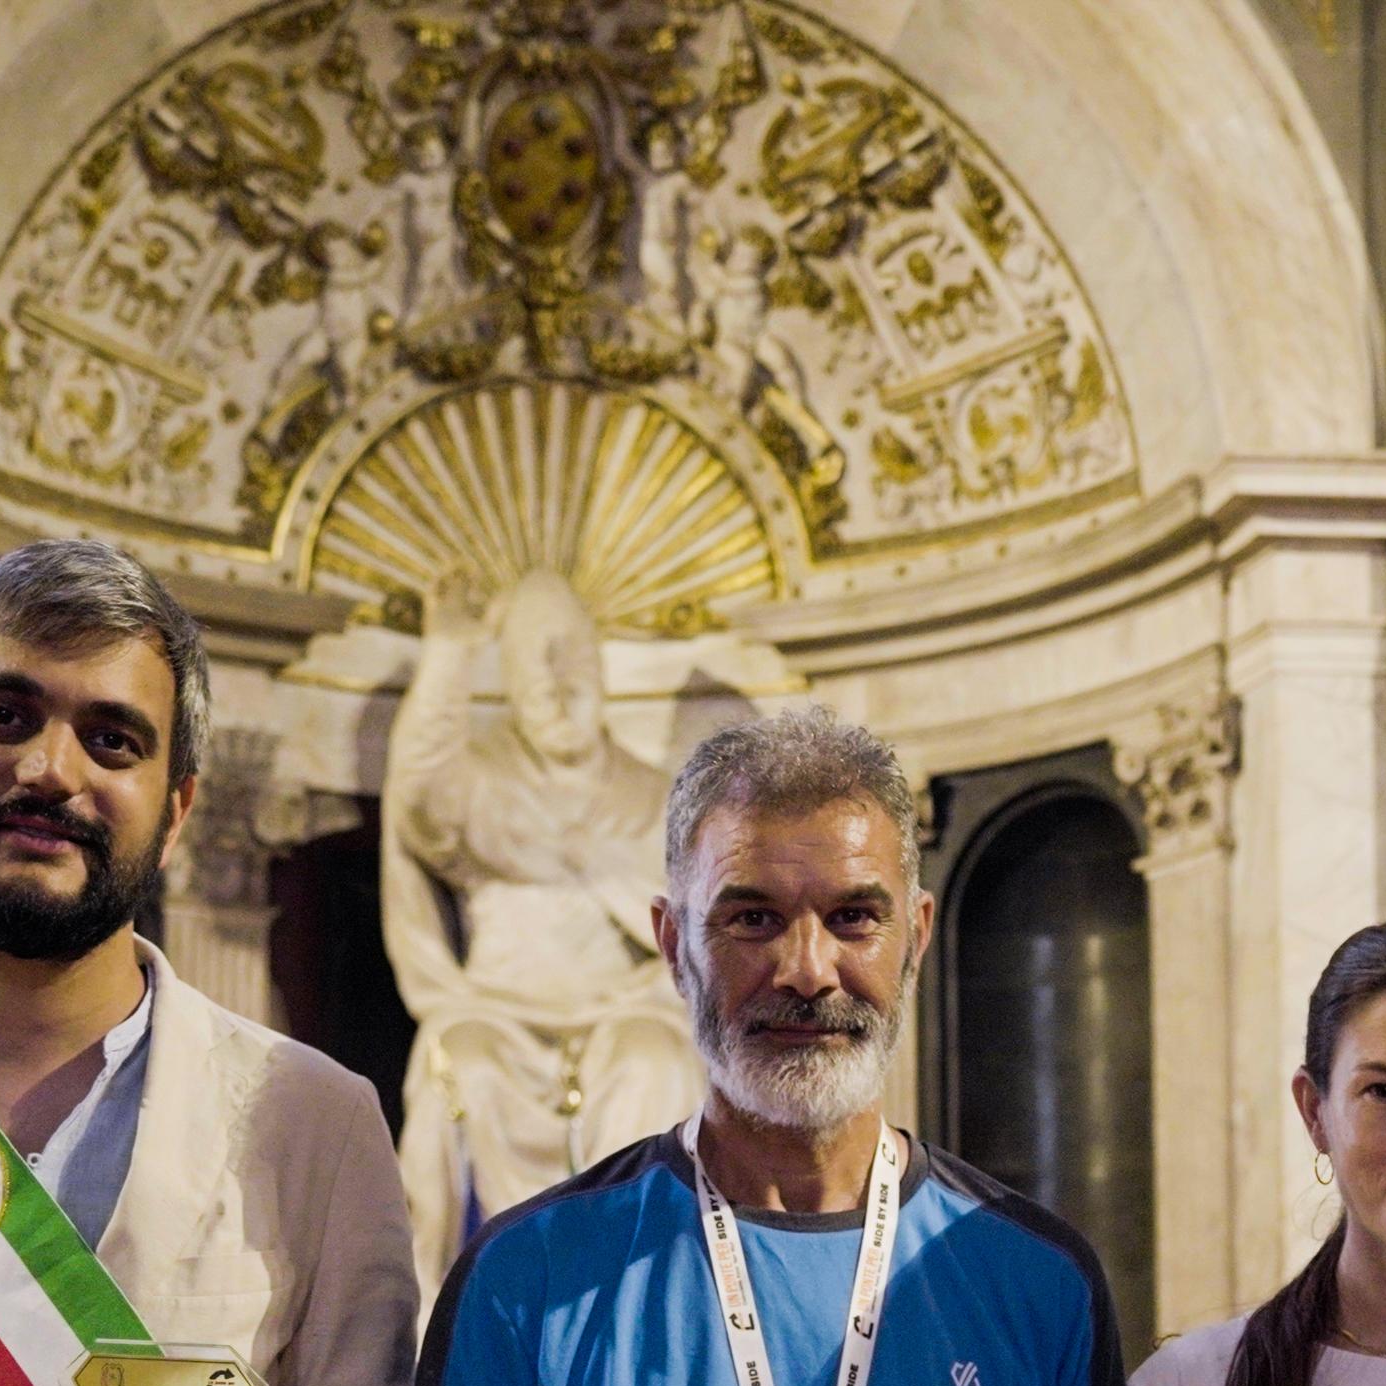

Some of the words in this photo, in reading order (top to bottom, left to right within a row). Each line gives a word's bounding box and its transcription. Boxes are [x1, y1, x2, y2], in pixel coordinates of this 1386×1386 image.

[879, 1183, 889, 1204] SIDE
[709, 1197, 720, 1212] BY
[877, 1207, 887, 1220] BY
[714, 1215, 727, 1240] SIDE
[874, 1223, 885, 1247] SIDE
[715, 1242, 731, 1260] PER
